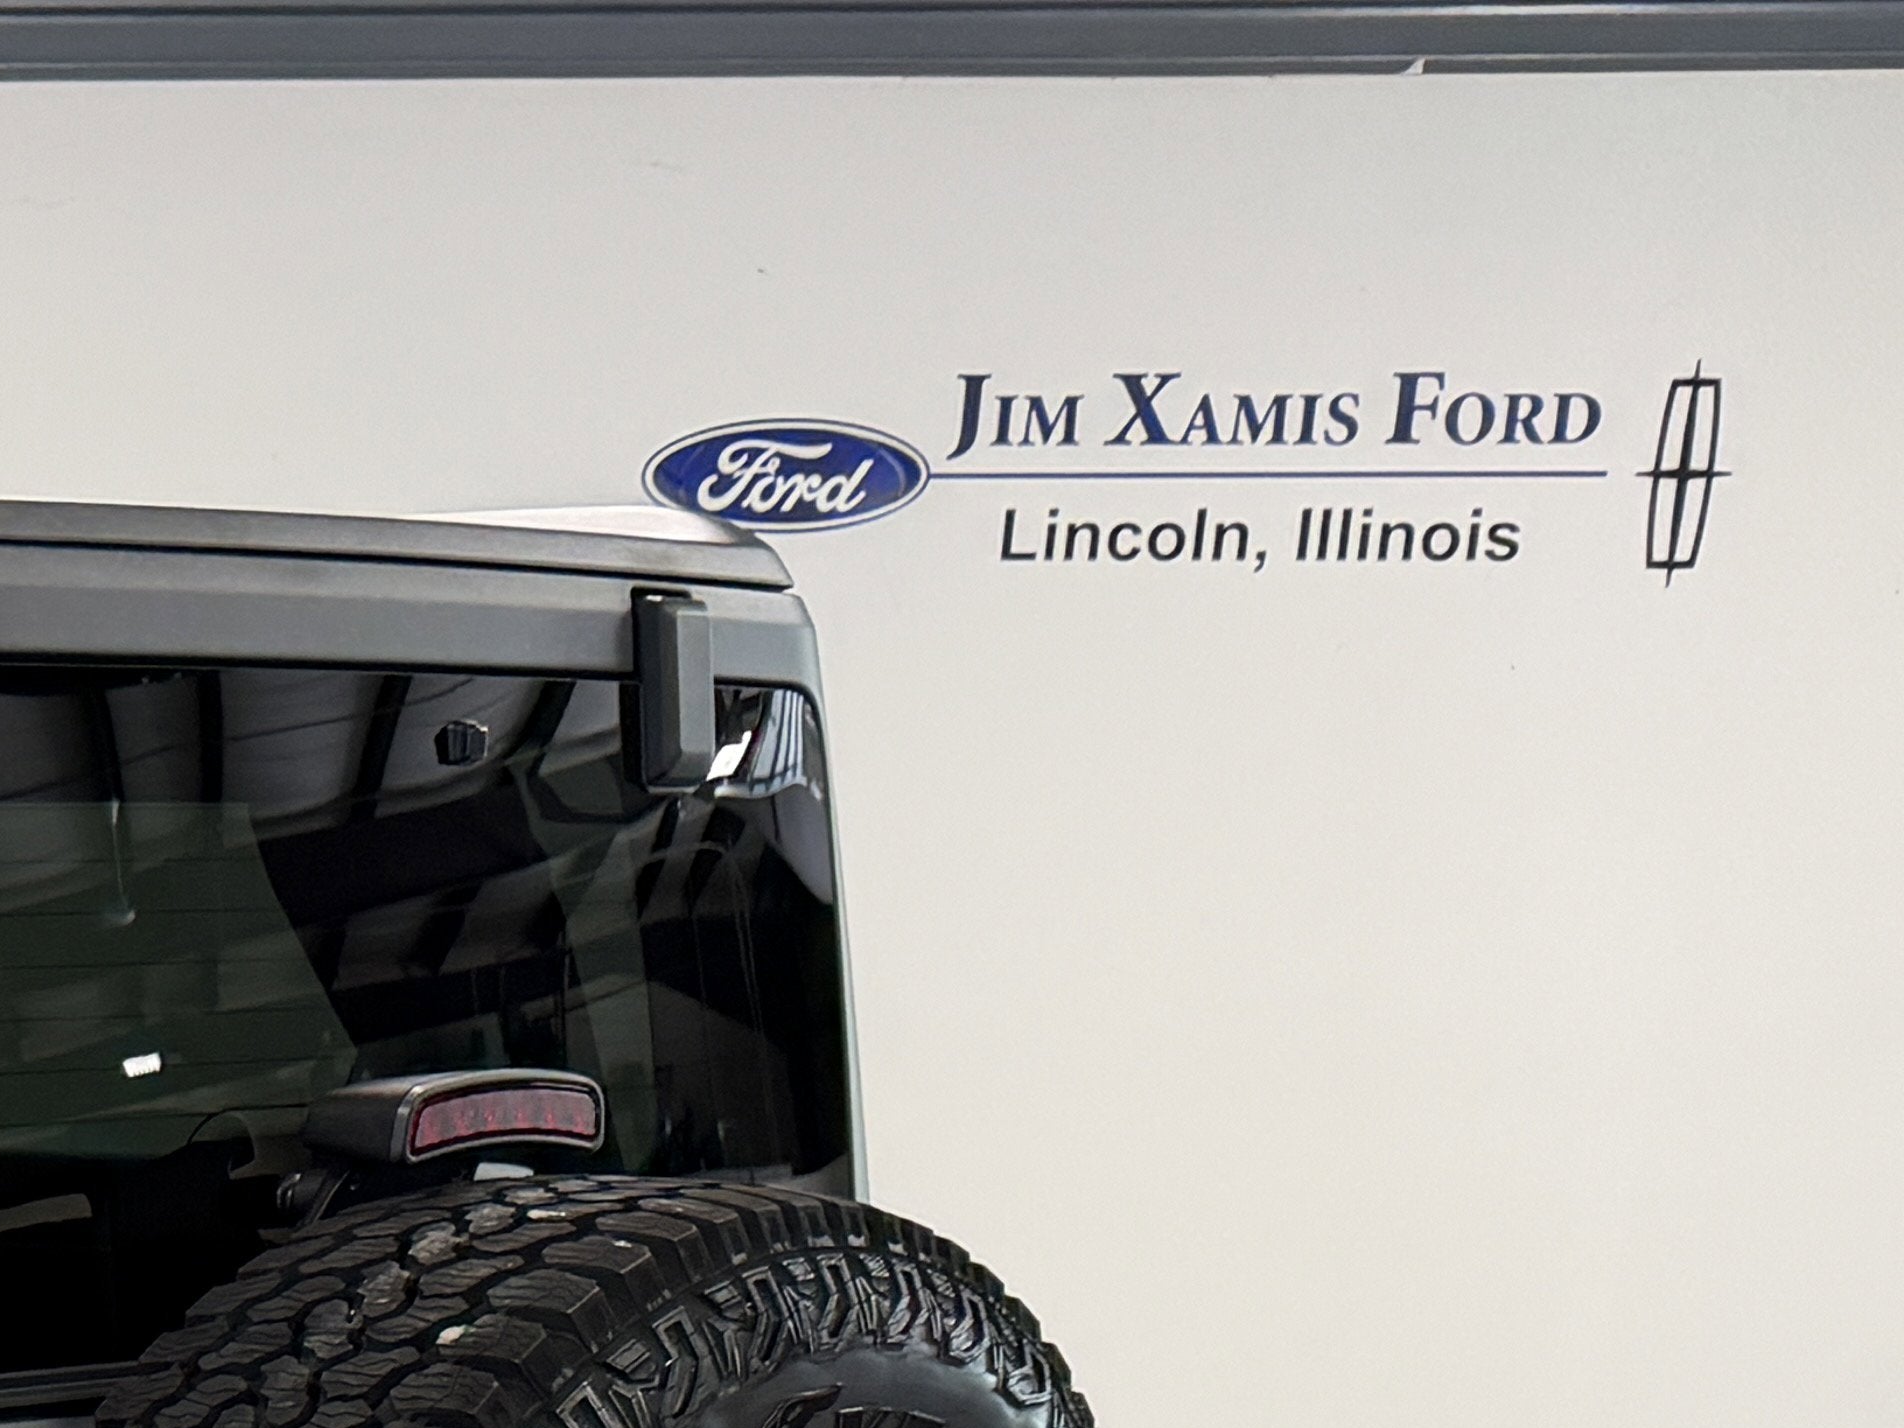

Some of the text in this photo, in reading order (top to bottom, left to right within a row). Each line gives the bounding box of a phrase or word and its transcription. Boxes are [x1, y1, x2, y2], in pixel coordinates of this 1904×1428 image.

[696, 439, 867, 515] Ford
[999, 507, 1521, 572] Lincoln, Illinois
